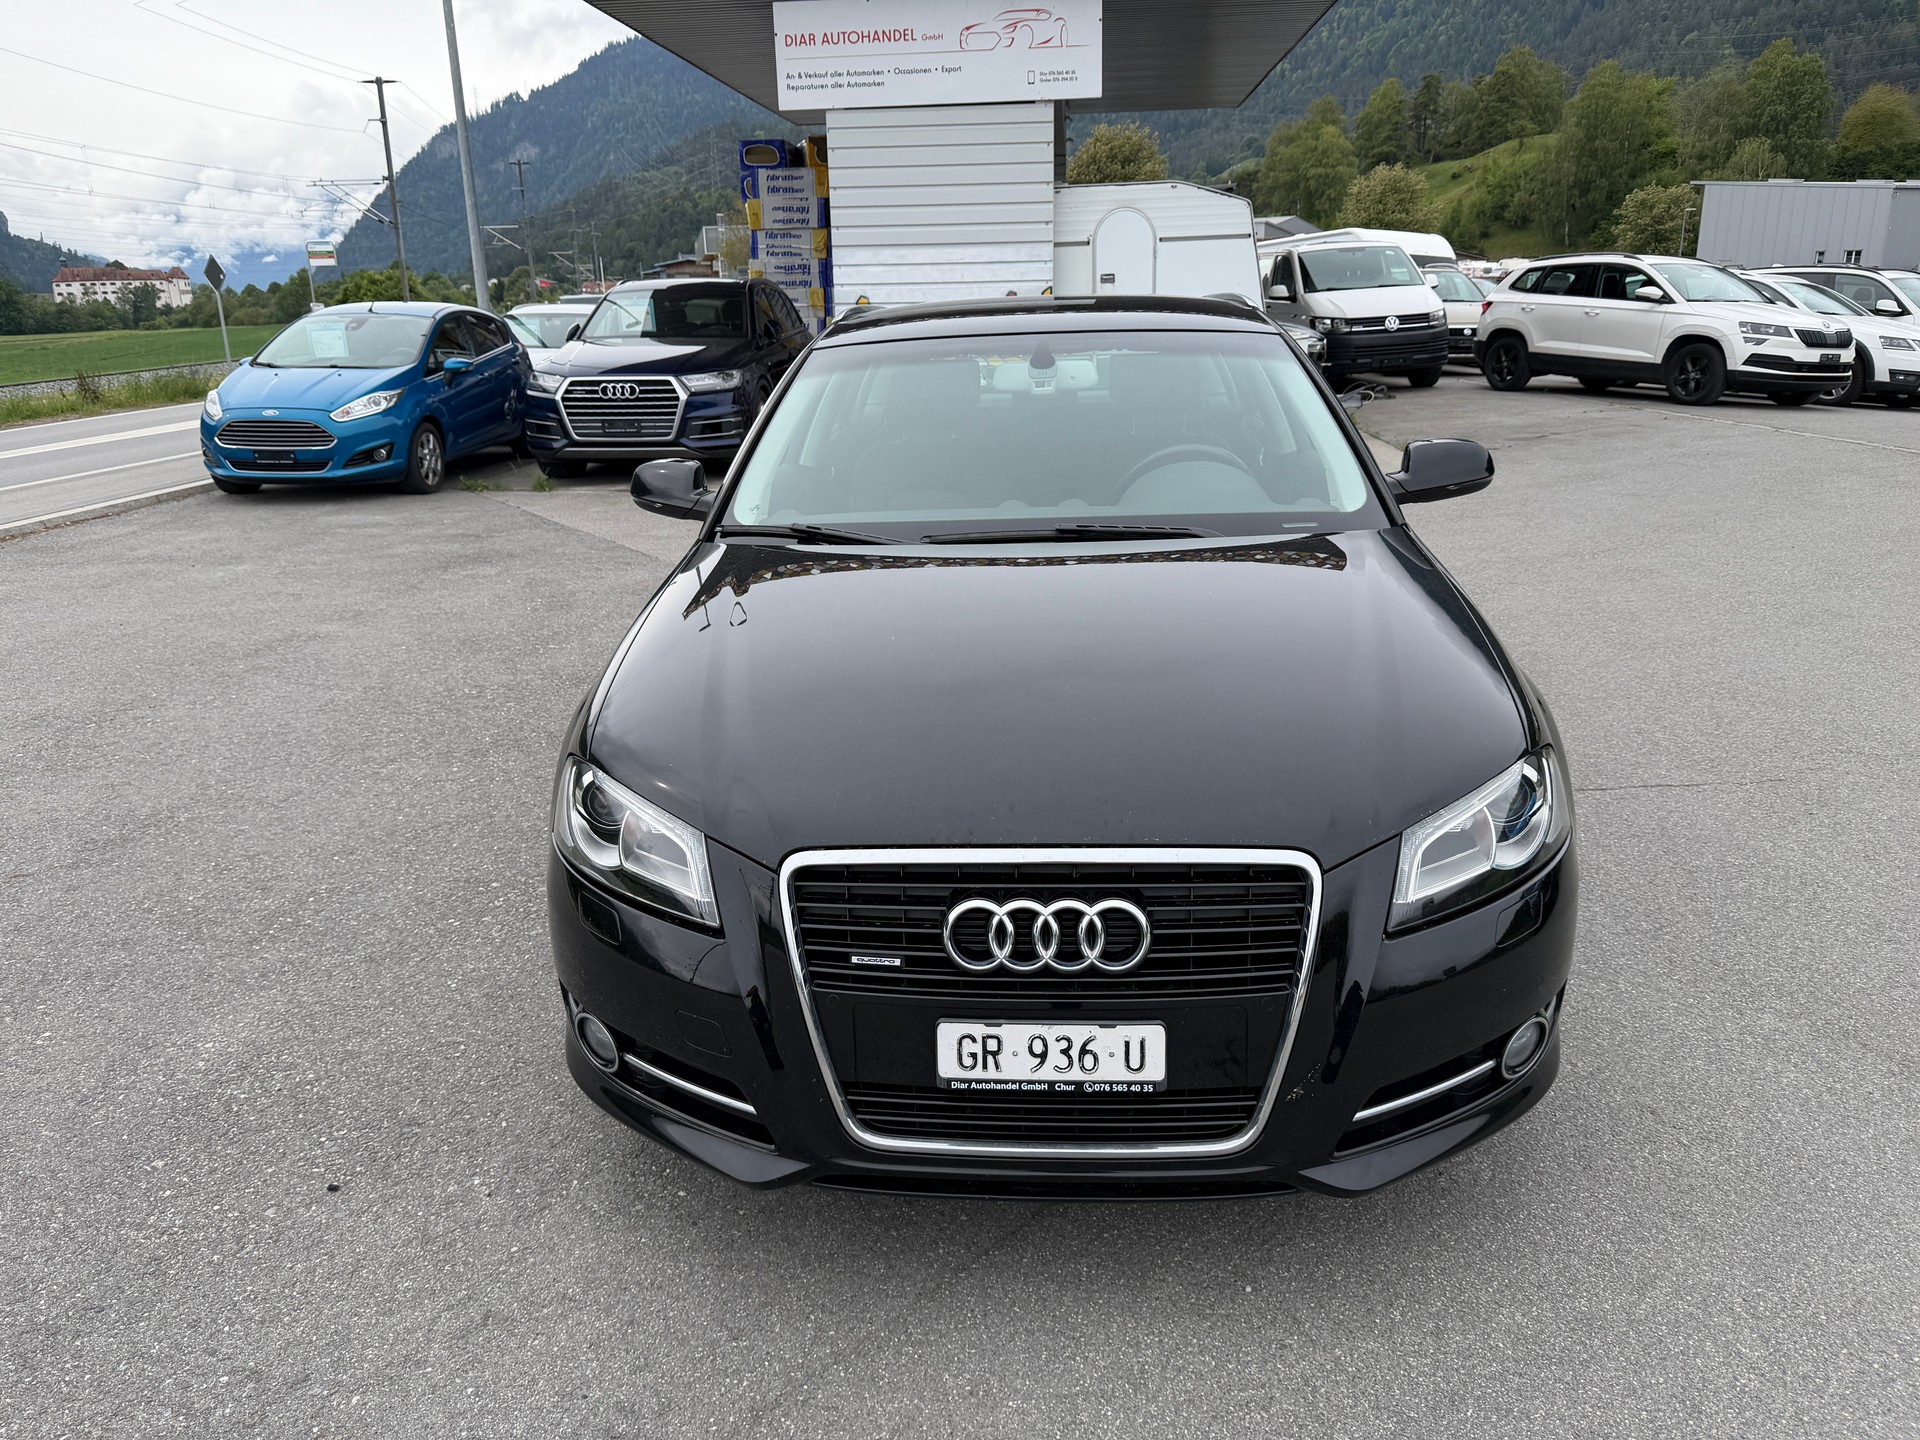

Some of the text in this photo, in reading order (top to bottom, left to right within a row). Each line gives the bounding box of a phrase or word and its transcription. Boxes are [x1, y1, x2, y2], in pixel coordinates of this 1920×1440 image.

[784, 28, 944, 48] DIAR AUTOHANDEL GmbH
[797, 72, 803, 80] &
[803, 70, 828, 79] Verkauf
[829, 70, 845, 78] aller
[846, 68, 885, 77] Automarken
[893, 67, 932, 75] Occasionen
[941, 65, 962, 75] Export
[786, 80, 885, 92] Reparaturen aller Automarken
[956, 1032, 1146, 1075] GR 936 U
[951, 1081, 1154, 1092] Diar Autohandel GmbH Chur 076 565 40 35
